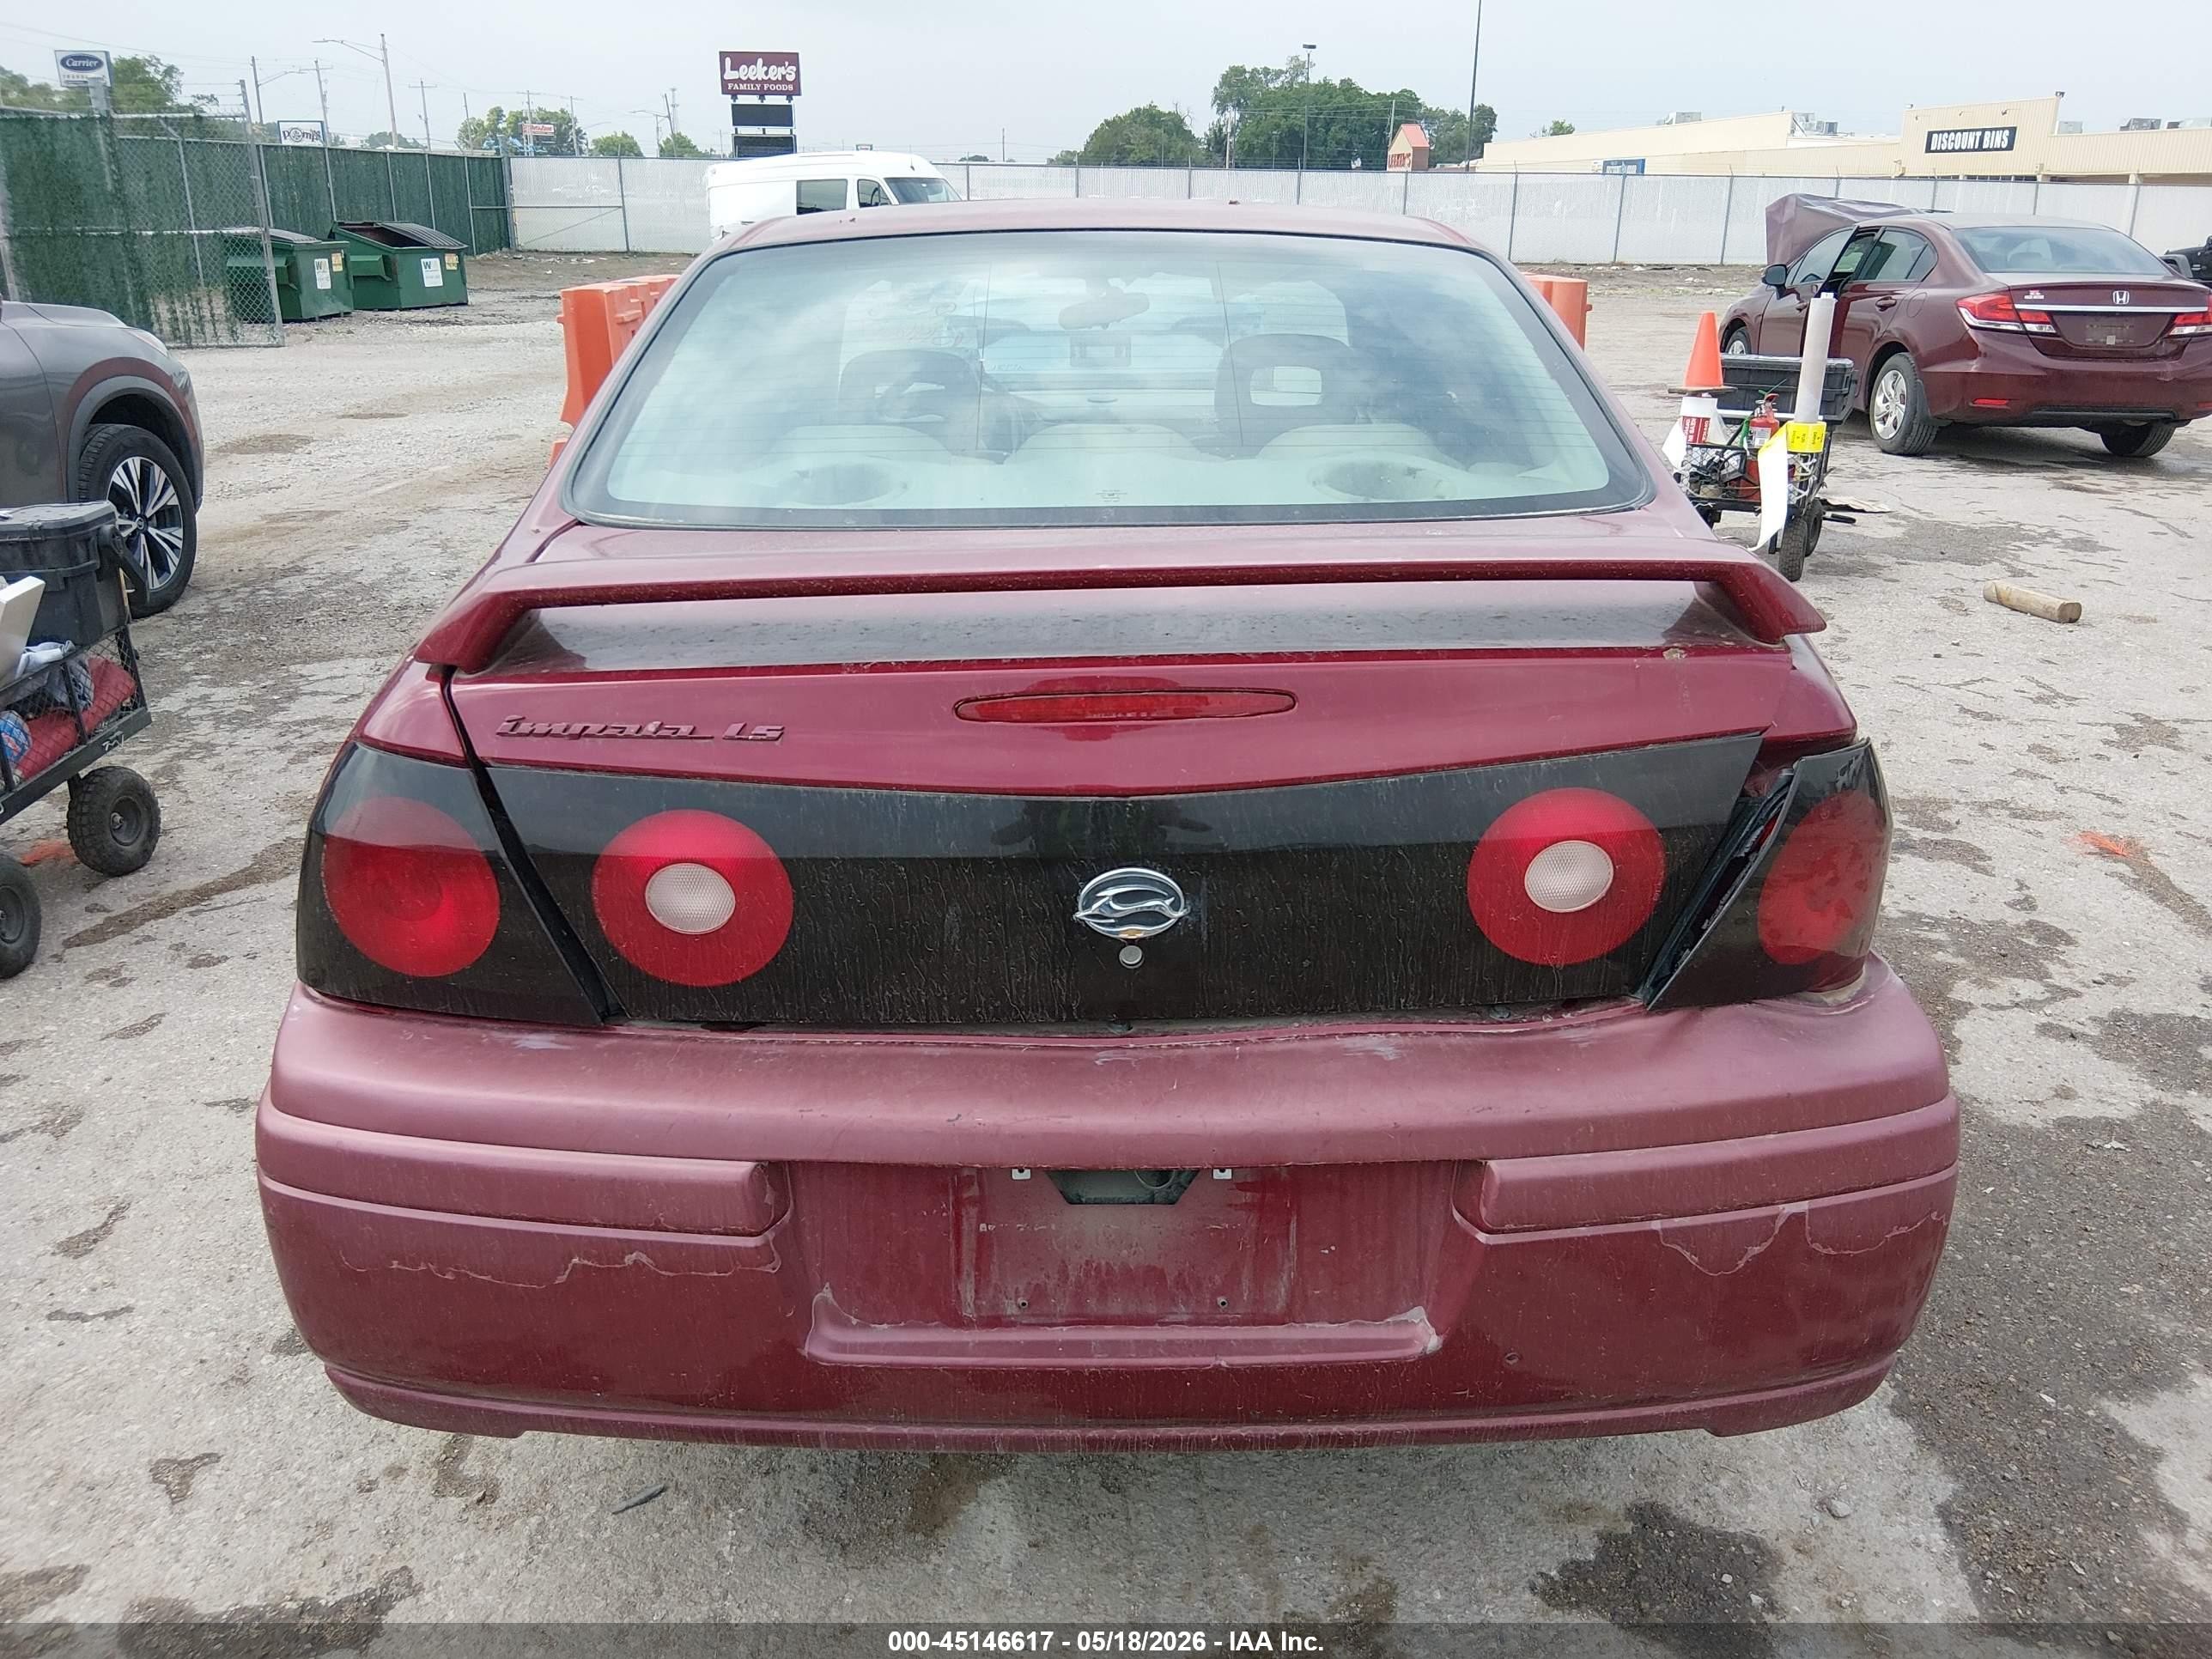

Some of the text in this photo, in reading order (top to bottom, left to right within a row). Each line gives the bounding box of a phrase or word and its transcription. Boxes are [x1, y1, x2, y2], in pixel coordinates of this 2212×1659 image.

[66, 58, 99, 68] Carrier
[724, 57, 797, 82] Leeker's
[1930, 130, 2009, 150] DISCOUNT BINS
